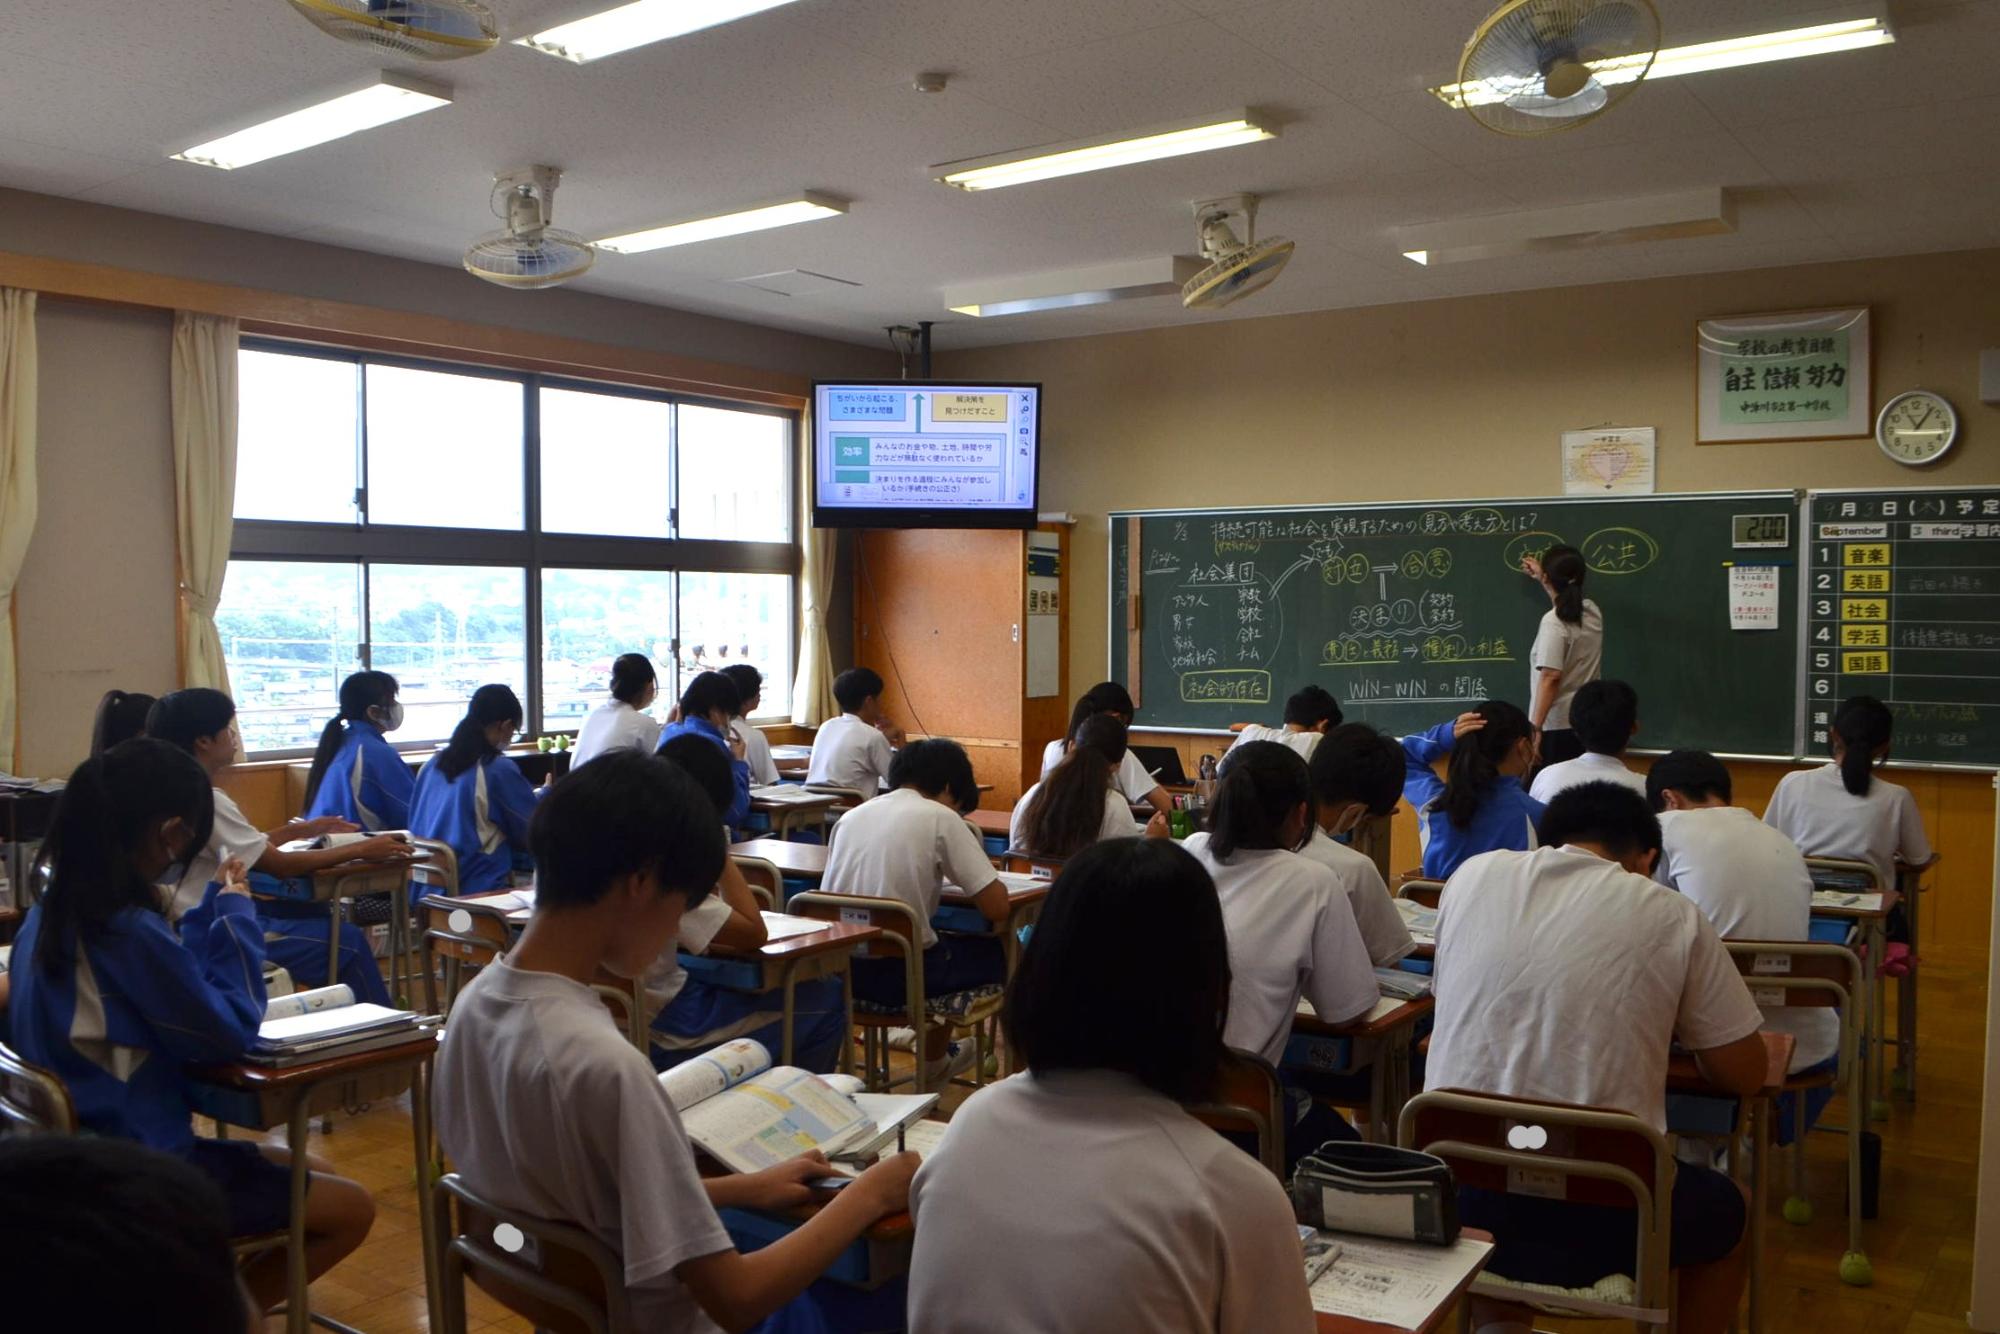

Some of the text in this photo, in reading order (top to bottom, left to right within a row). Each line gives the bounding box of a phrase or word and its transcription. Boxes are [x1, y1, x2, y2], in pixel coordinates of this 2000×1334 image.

[1737, 337, 1836, 357] 学校の教育目標
[1725, 362, 1846, 391] 自主 信頼 努力
[1740, 400, 1832, 413] 中津川市立第一中学校
[1403, 550, 1451, 578] 合意
[1591, 542, 1637, 570] 公共
[1820, 547, 1884, 564] 1 音楽
[1187, 561, 1255, 584] 社会集団
[1817, 574, 1884, 590] 2 英語
[1236, 606, 1263, 626] 学校
[1351, 603, 1408, 626] 決まり
[1816, 600, 1881, 619] 3 社会
[1236, 625, 1263, 644] 会社
[1816, 627, 1881, 645] 4 学活
[1238, 646, 1261, 662] チーム
[1815, 653, 1882, 672] 5 国語
[1185, 676, 1266, 701] 社会的存在
[1349, 679, 1427, 700] WIN-WIN
[1454, 677, 1488, 700] 関係
[1815, 679, 1829, 694] 6
